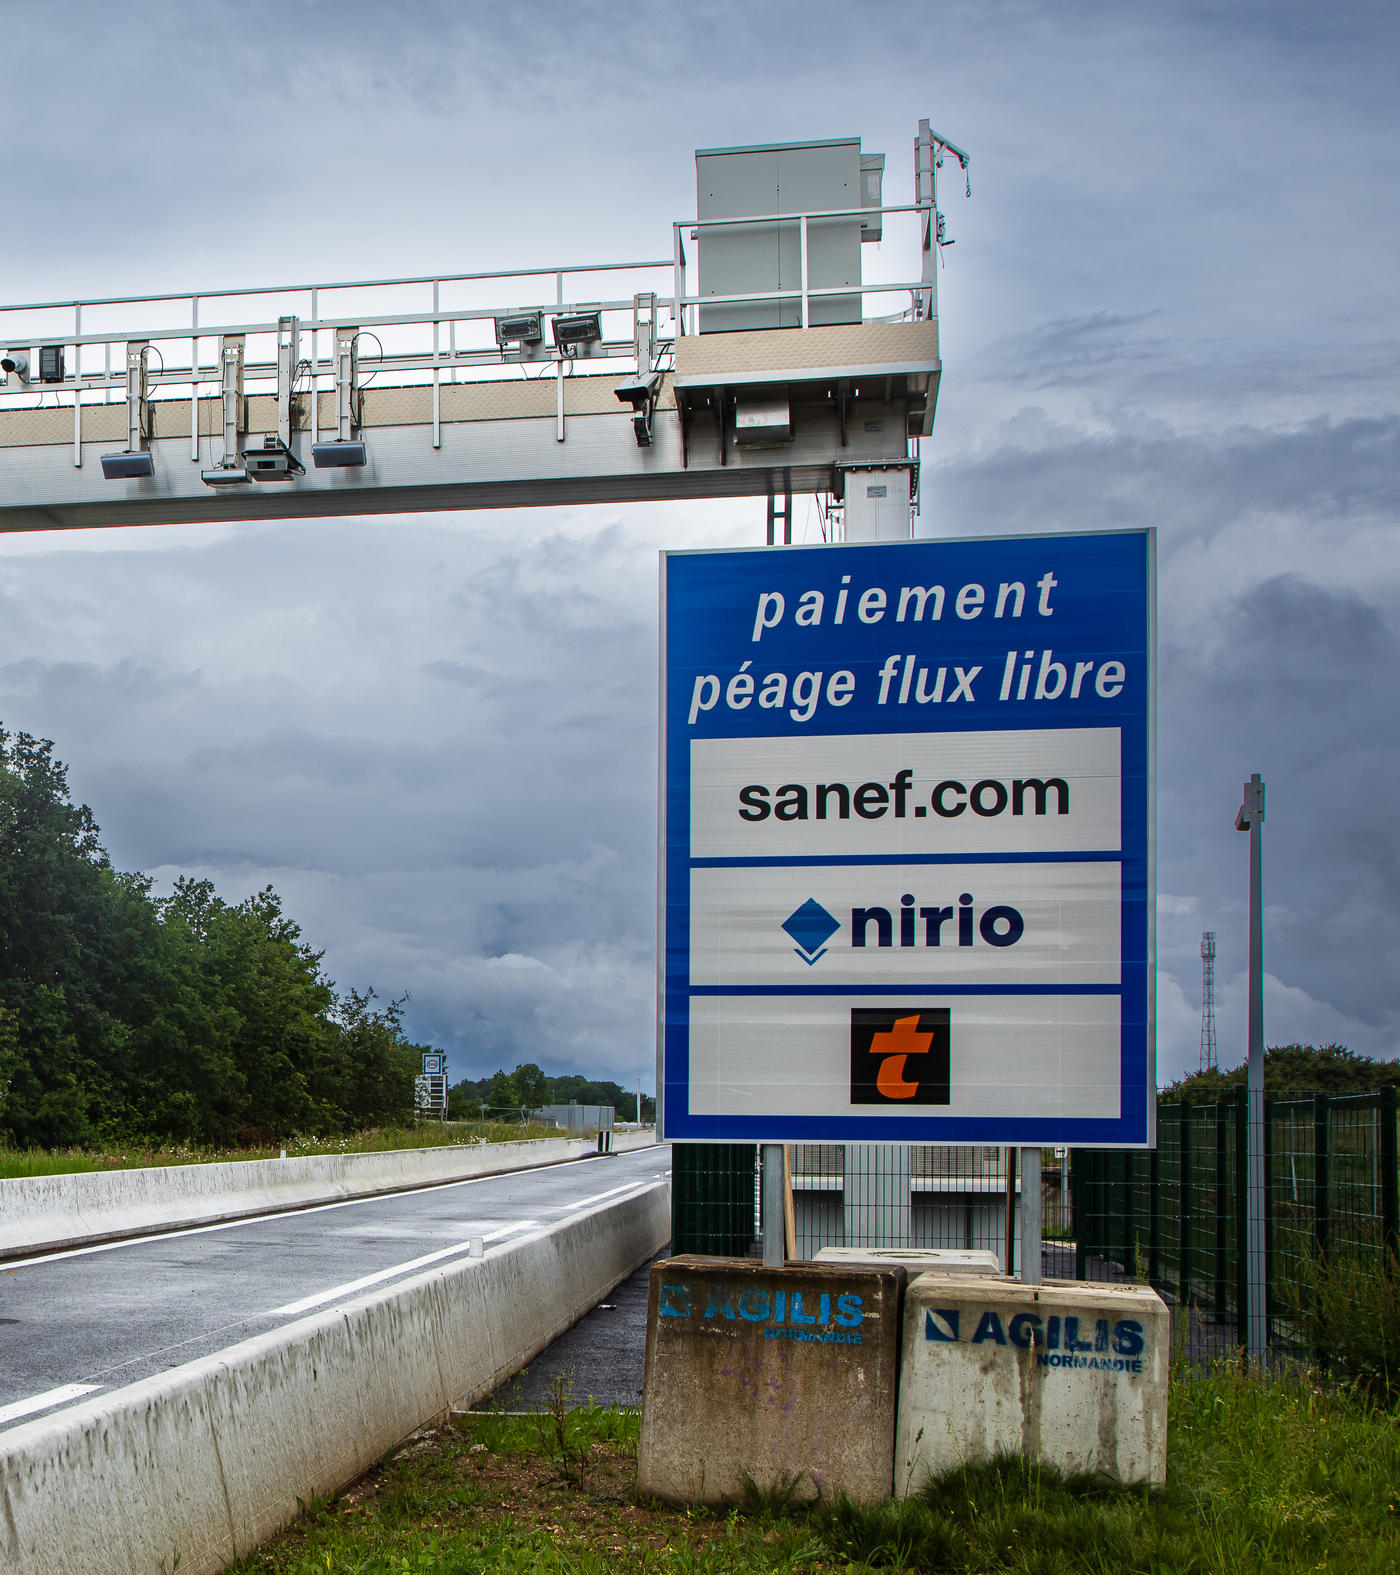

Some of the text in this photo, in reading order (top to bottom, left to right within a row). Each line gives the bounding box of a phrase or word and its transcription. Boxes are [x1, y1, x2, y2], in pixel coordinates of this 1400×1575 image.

[752, 571, 1058, 642] paiement
[687, 648, 1127, 725] péage flux libre
[737, 769, 1070, 822] sanef.com
[851, 892, 1025, 948] nirio
[703, 1287, 865, 1328] AGILIS
[764, 1327, 864, 1345] NORMANDIE
[971, 1311, 1146, 1355] AGILIS
[1036, 1353, 1144, 1373] NORMANDIE
